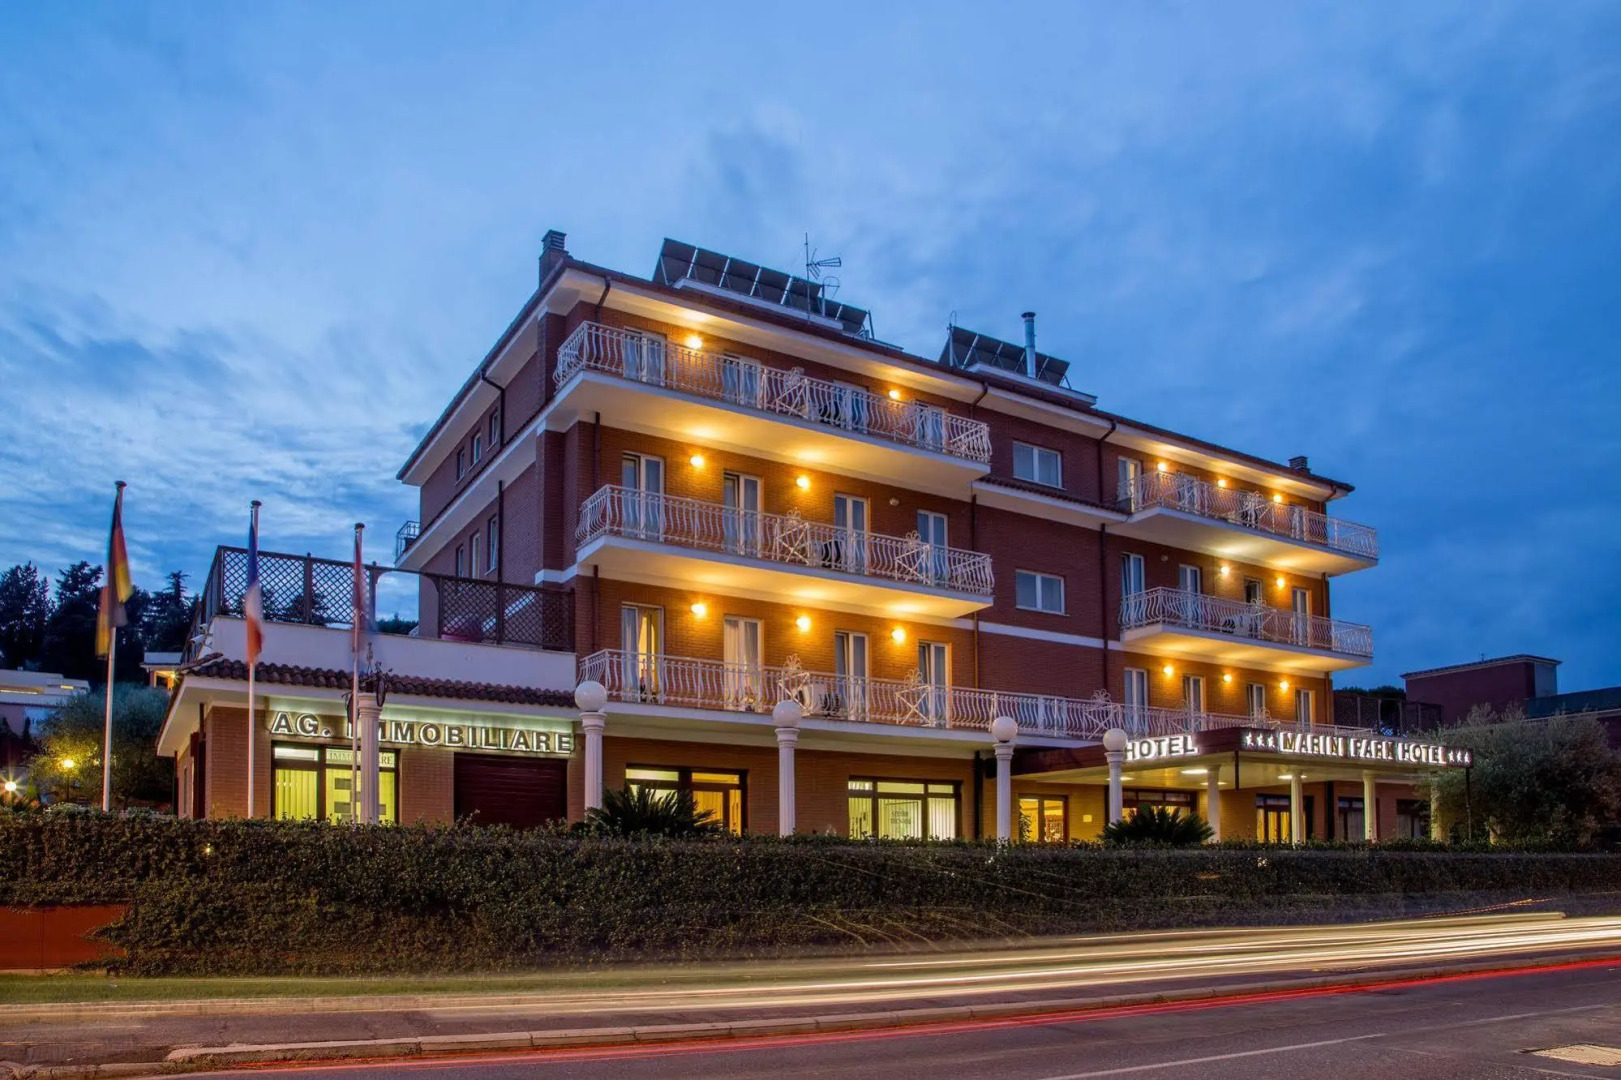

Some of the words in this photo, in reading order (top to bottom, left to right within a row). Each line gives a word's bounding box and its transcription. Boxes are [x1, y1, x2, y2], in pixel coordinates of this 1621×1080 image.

[271, 711, 332, 737] AG.
[1124, 735, 1198, 761] HOTEL
[1349, 738, 1394, 760] PARK
[1397, 742, 1447, 764] HOTEL
